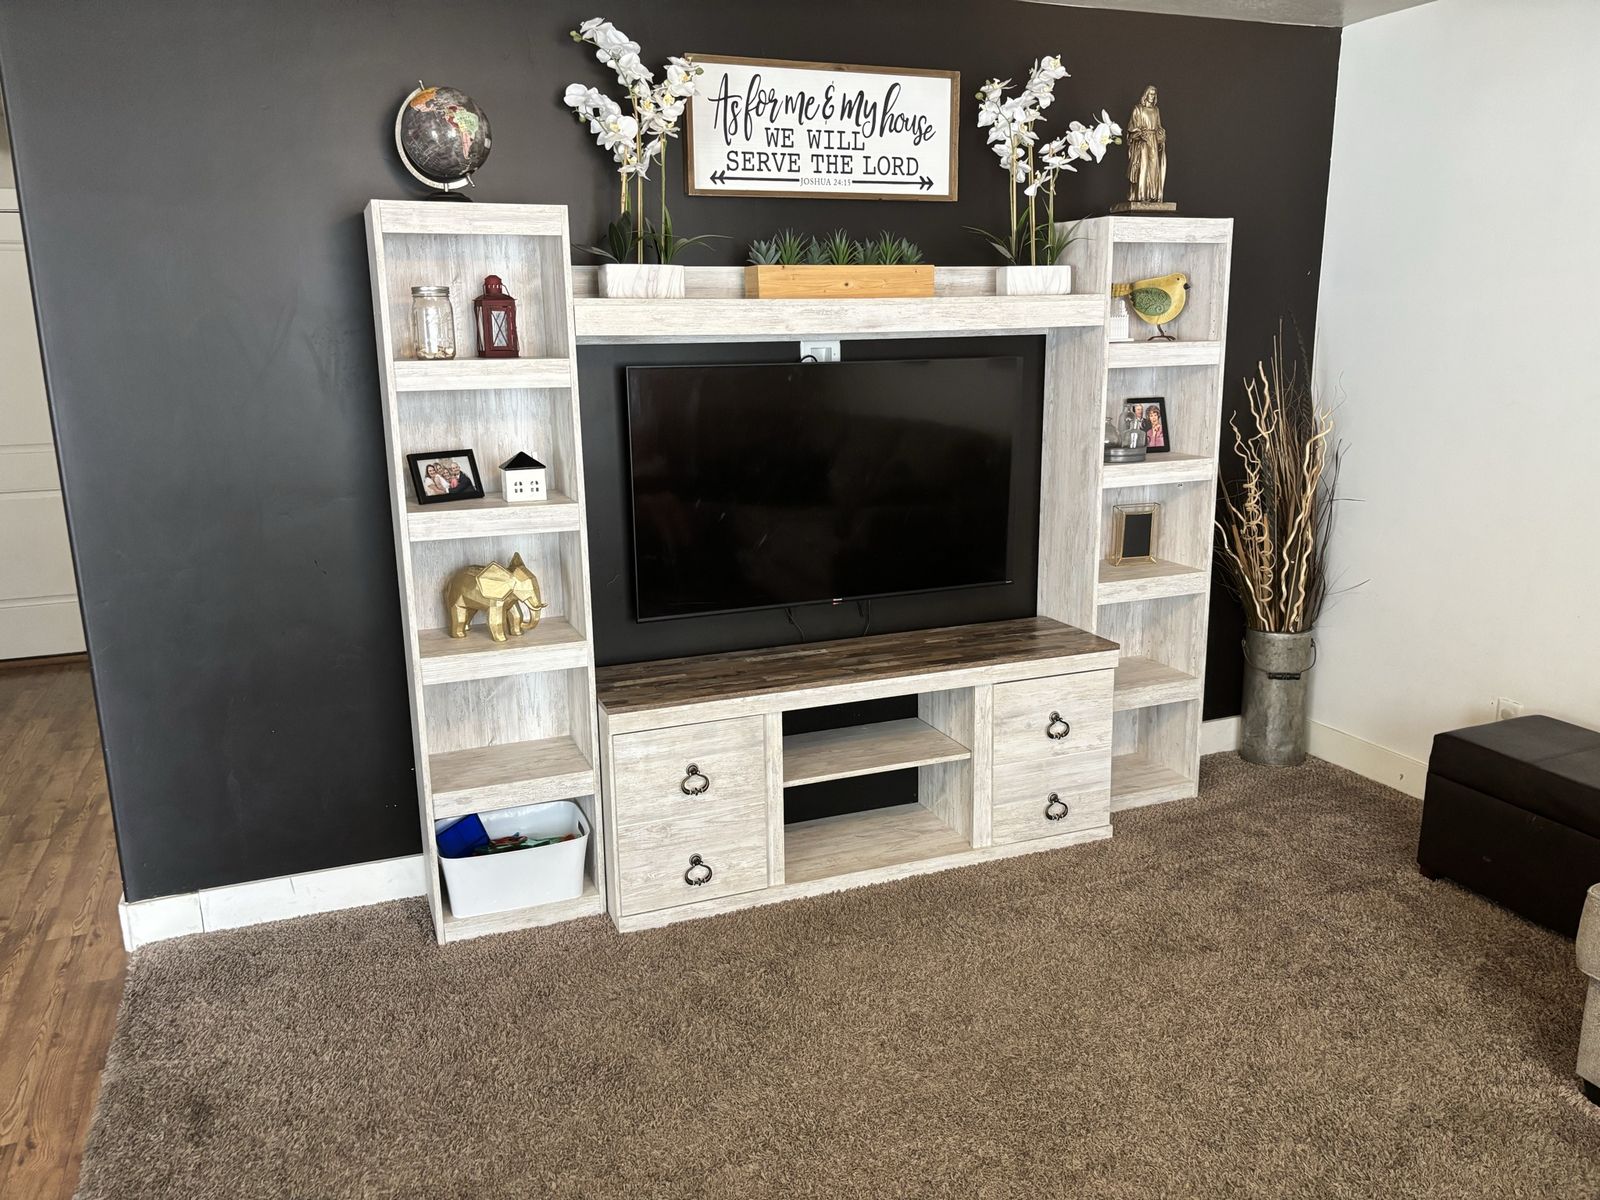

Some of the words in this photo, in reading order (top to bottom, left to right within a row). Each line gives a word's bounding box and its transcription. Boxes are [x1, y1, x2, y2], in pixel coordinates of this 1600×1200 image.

[707, 72, 742, 146] As
[744, 73, 783, 141] for
[784, 91, 819, 125] me
[821, 80, 835, 125] &
[839, 90, 877, 138] my
[879, 82, 936, 146] house
[765, 127, 794, 148] WE
[807, 129, 865, 151] WILL
[726, 150, 801, 173] SERVE
[811, 154, 853, 174] THE
[862, 155, 919, 176] LORD
[800, 177, 831, 187] JOSHUA
